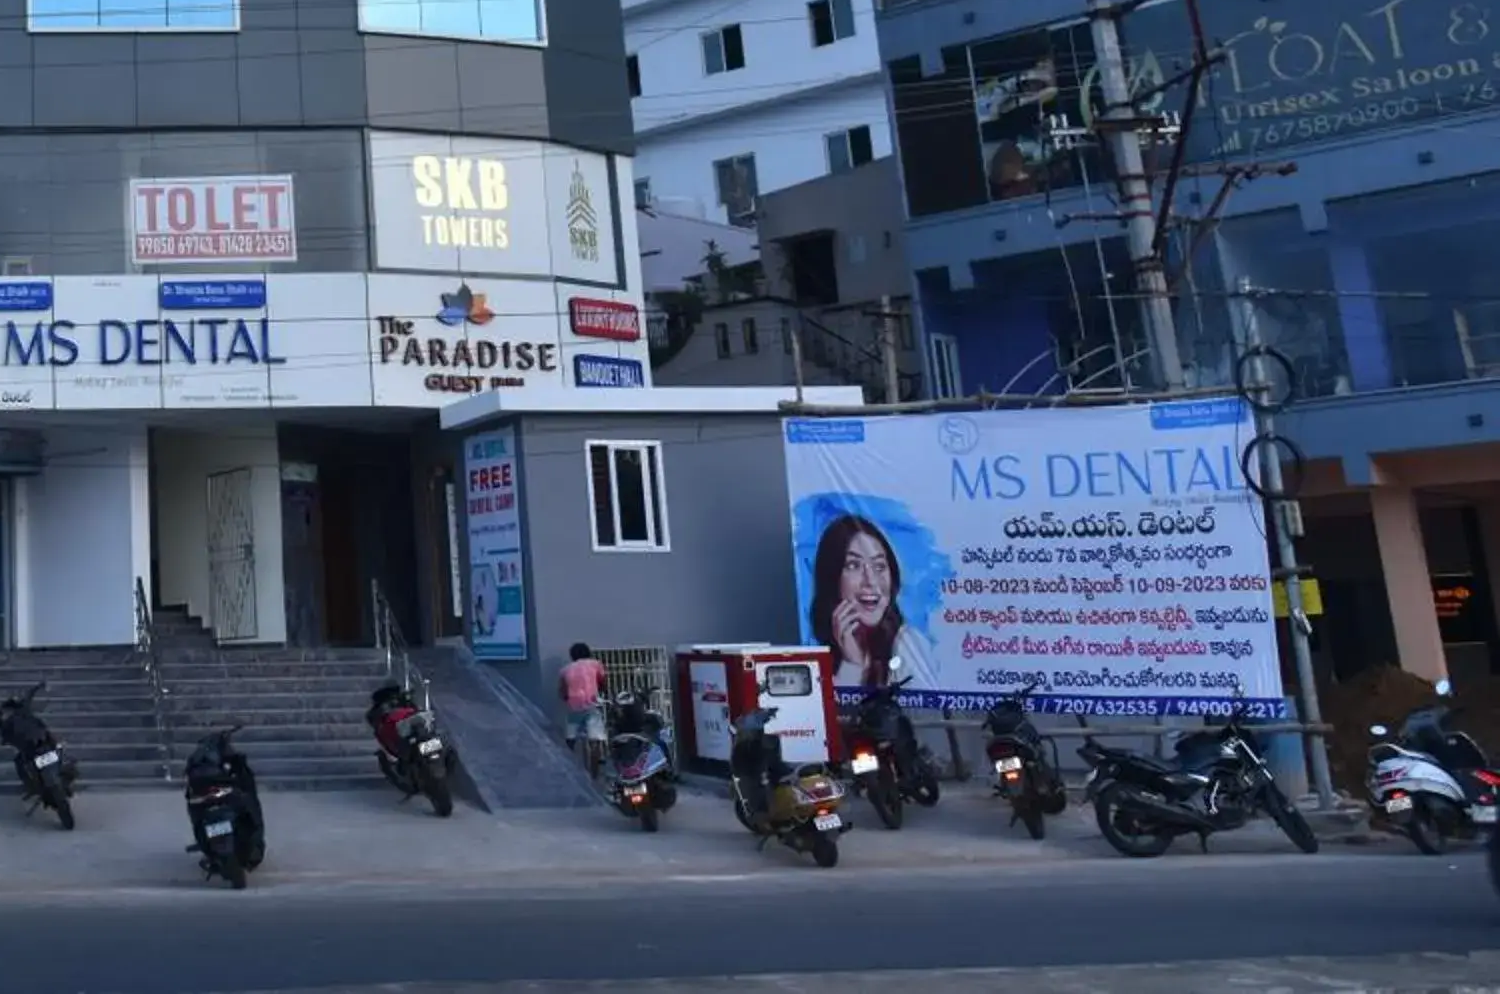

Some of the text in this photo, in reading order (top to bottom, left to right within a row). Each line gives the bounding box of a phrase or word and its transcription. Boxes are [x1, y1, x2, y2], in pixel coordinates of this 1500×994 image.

[1220, 57, 1482, 126] Unisex Saloon
[412, 155, 509, 211] SKB
[137, 186, 286, 232] TO LET
[420, 214, 510, 250] TOWERS
[4, 318, 287, 367] MS DENTAL
[376, 315, 415, 336] The
[379, 335, 558, 372] PARADISE
[423, 372, 484, 393] GUEST
[469, 463, 512, 493] FREE
[951, 445, 1248, 501] MS DENTAL
[1137, 506, 1217, 536] డెంటల్
[940, 577, 1030, 595] 10-08-2023
[1128, 575, 1226, 594] 10-09-2023
[938, 694, 1036, 712] 7207935
[1053, 698, 1158, 716] 7207632535
